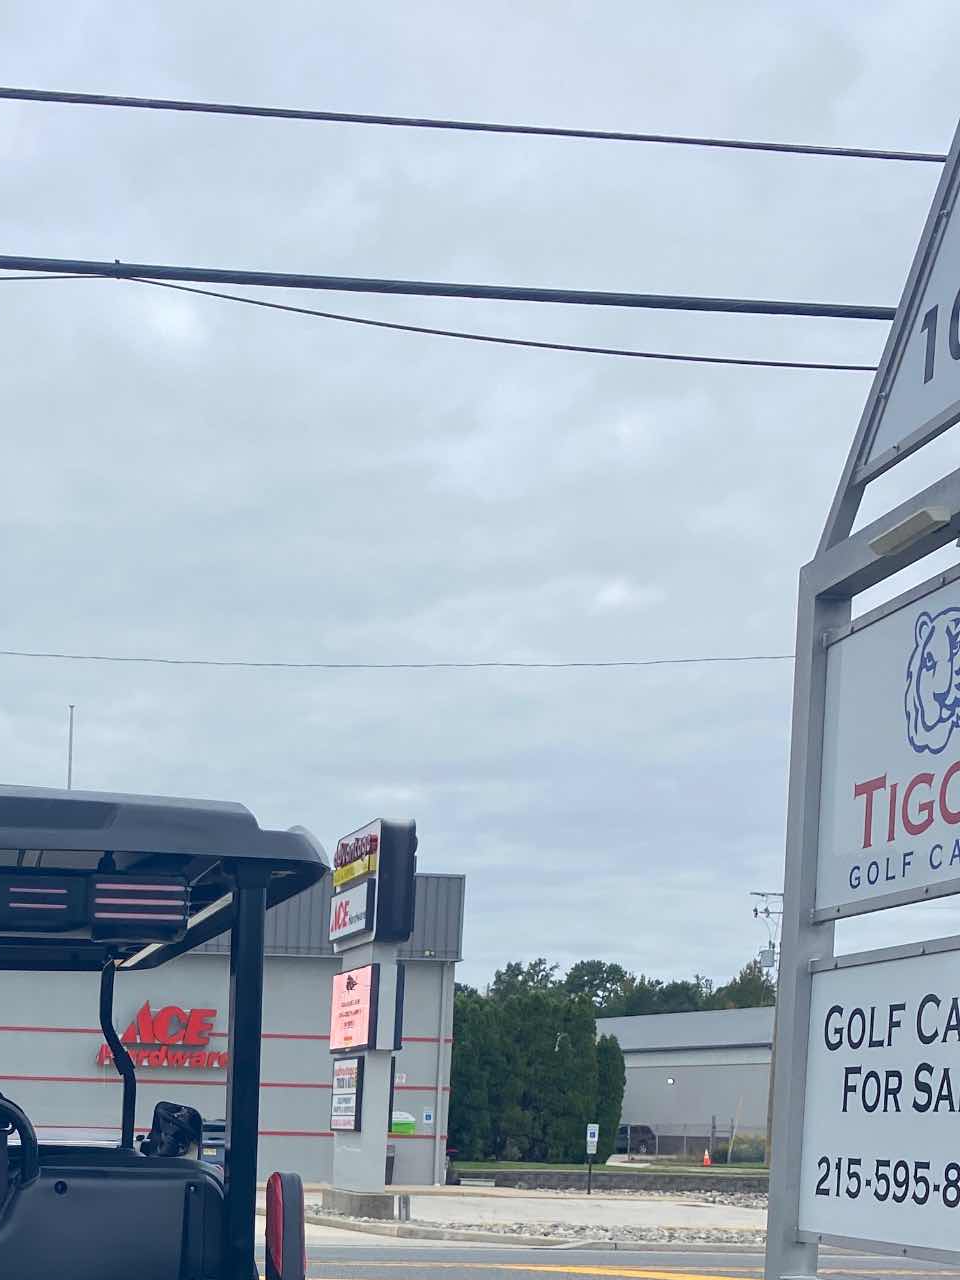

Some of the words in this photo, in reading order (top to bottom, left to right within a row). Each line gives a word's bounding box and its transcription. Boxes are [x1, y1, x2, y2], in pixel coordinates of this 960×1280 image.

[849, 851, 913, 889] GOLF
[120, 1000, 217, 1046] ACE
[824, 1002, 906, 1052] GOLF
[841, 1064, 903, 1113] FOR
[912, 1062, 960, 1113] SA
